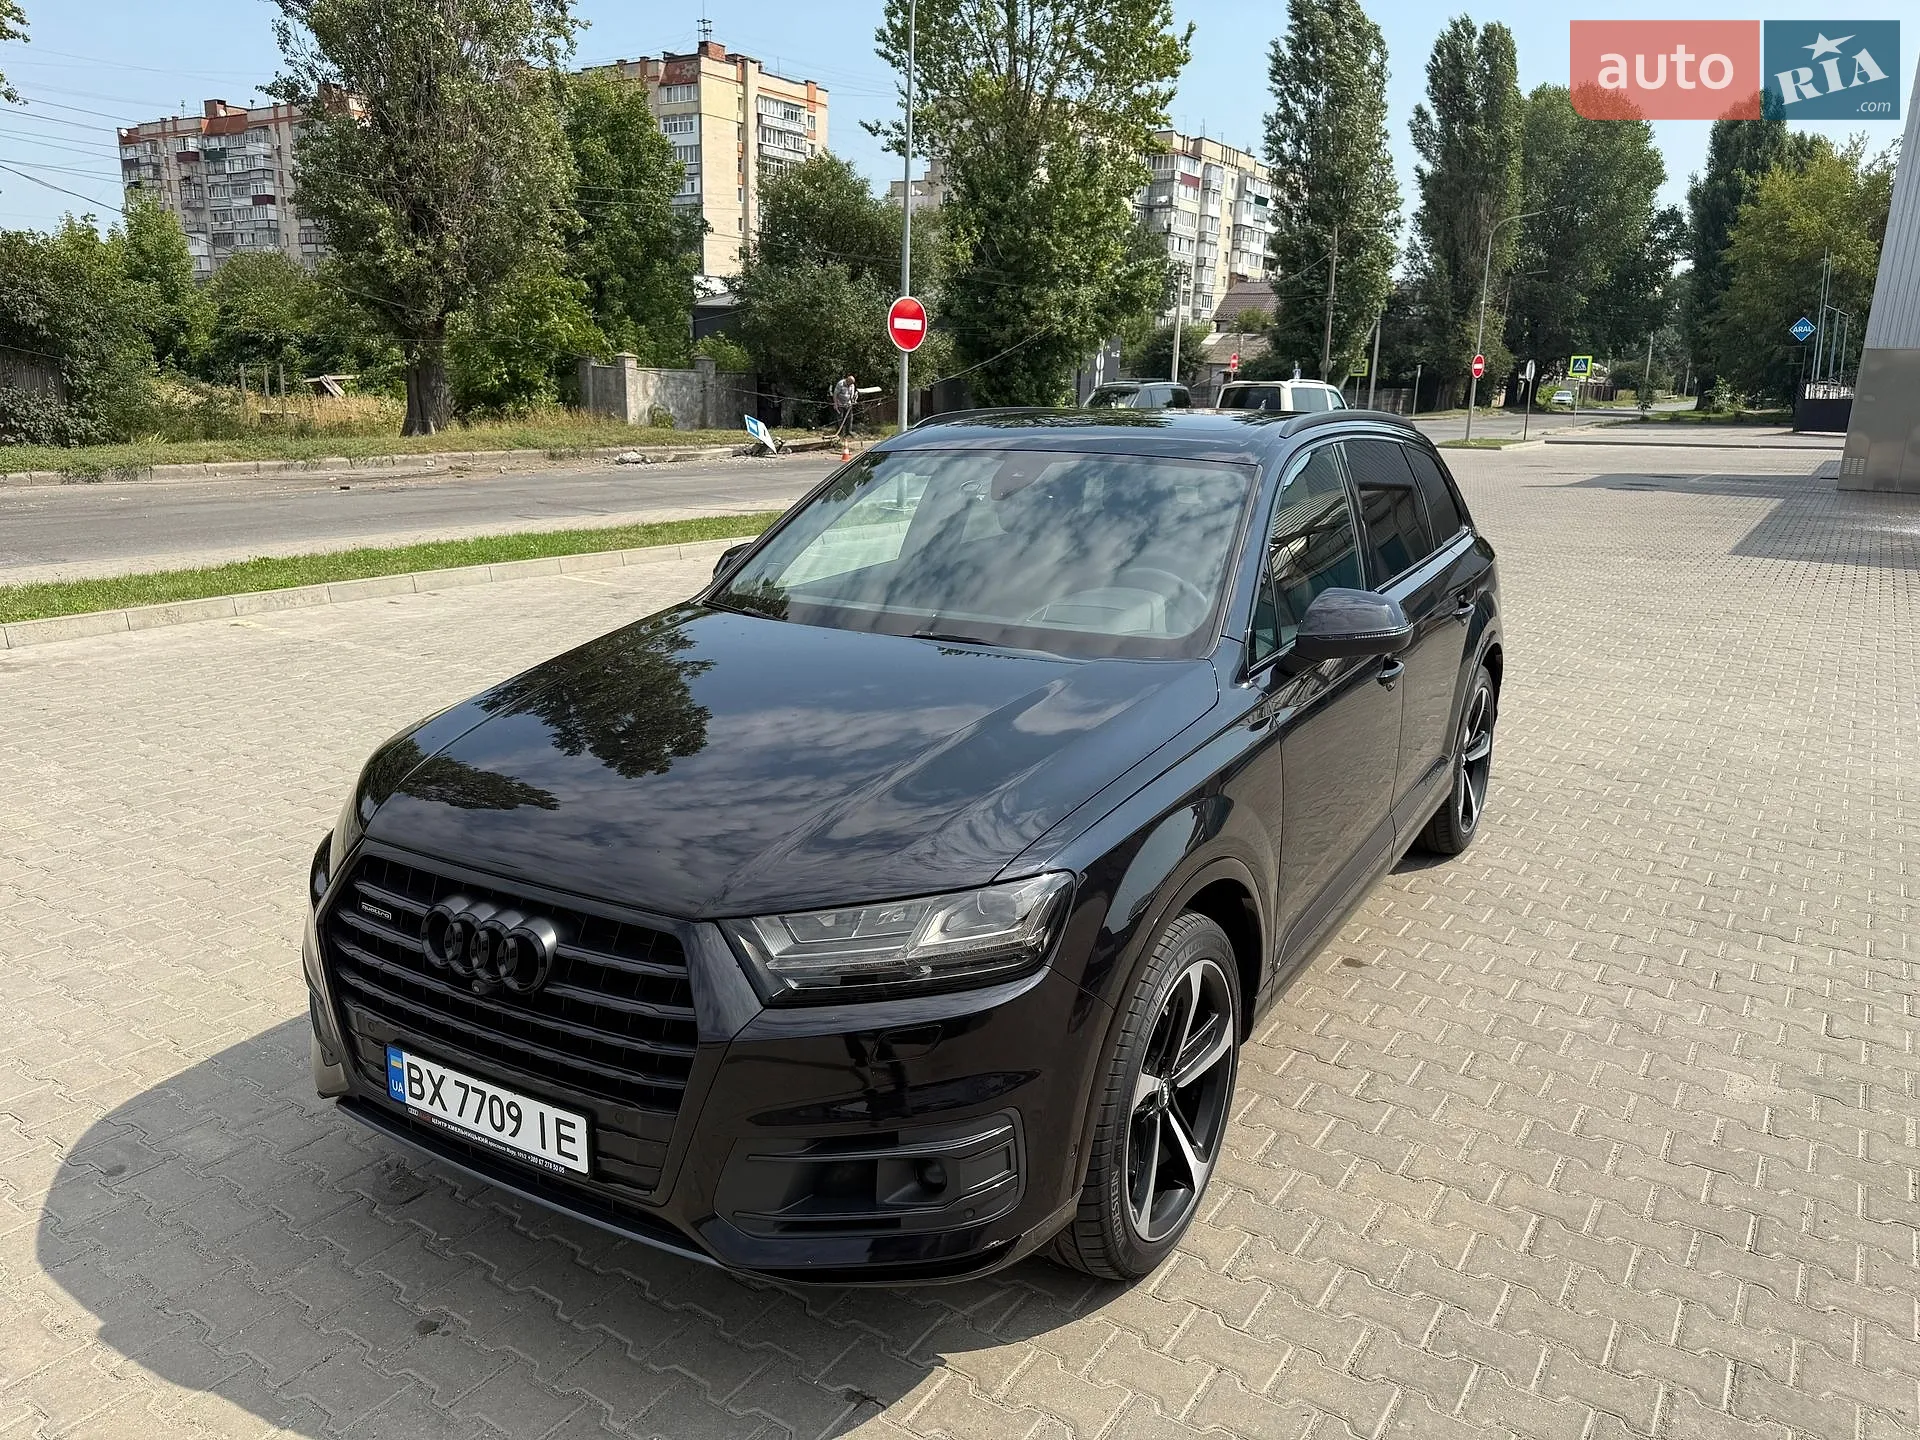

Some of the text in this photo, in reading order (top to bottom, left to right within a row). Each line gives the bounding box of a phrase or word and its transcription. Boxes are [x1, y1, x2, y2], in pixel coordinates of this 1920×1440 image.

[392, 1080, 404, 1094] UA
[406, 1061, 579, 1162] BX 7709 IE
